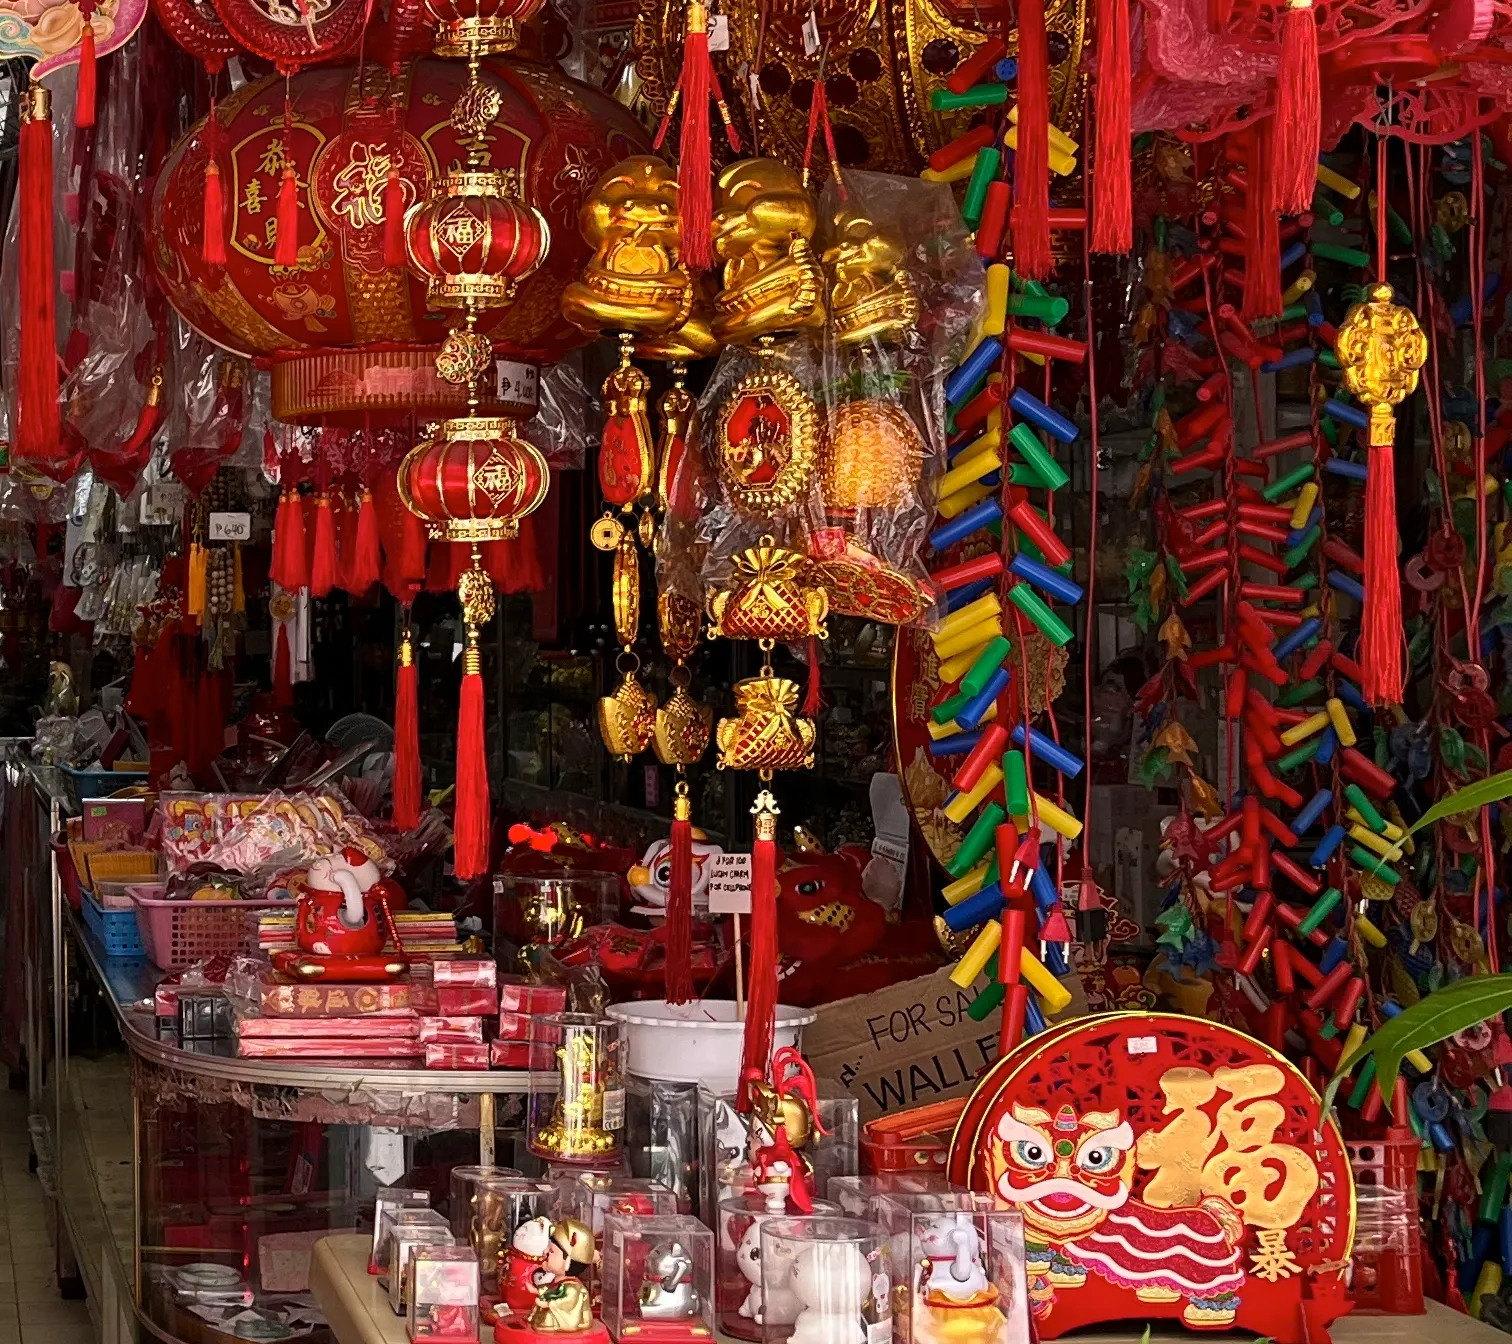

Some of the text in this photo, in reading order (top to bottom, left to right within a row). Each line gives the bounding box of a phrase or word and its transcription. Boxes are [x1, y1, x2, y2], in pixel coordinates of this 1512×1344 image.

[446, 218, 474, 244] 福
[478, 463, 513, 492] 福
[866, 1002, 932, 1051] FOR
[862, 1030, 1001, 1112] WALLE
[1136, 1064, 1319, 1229] 福
